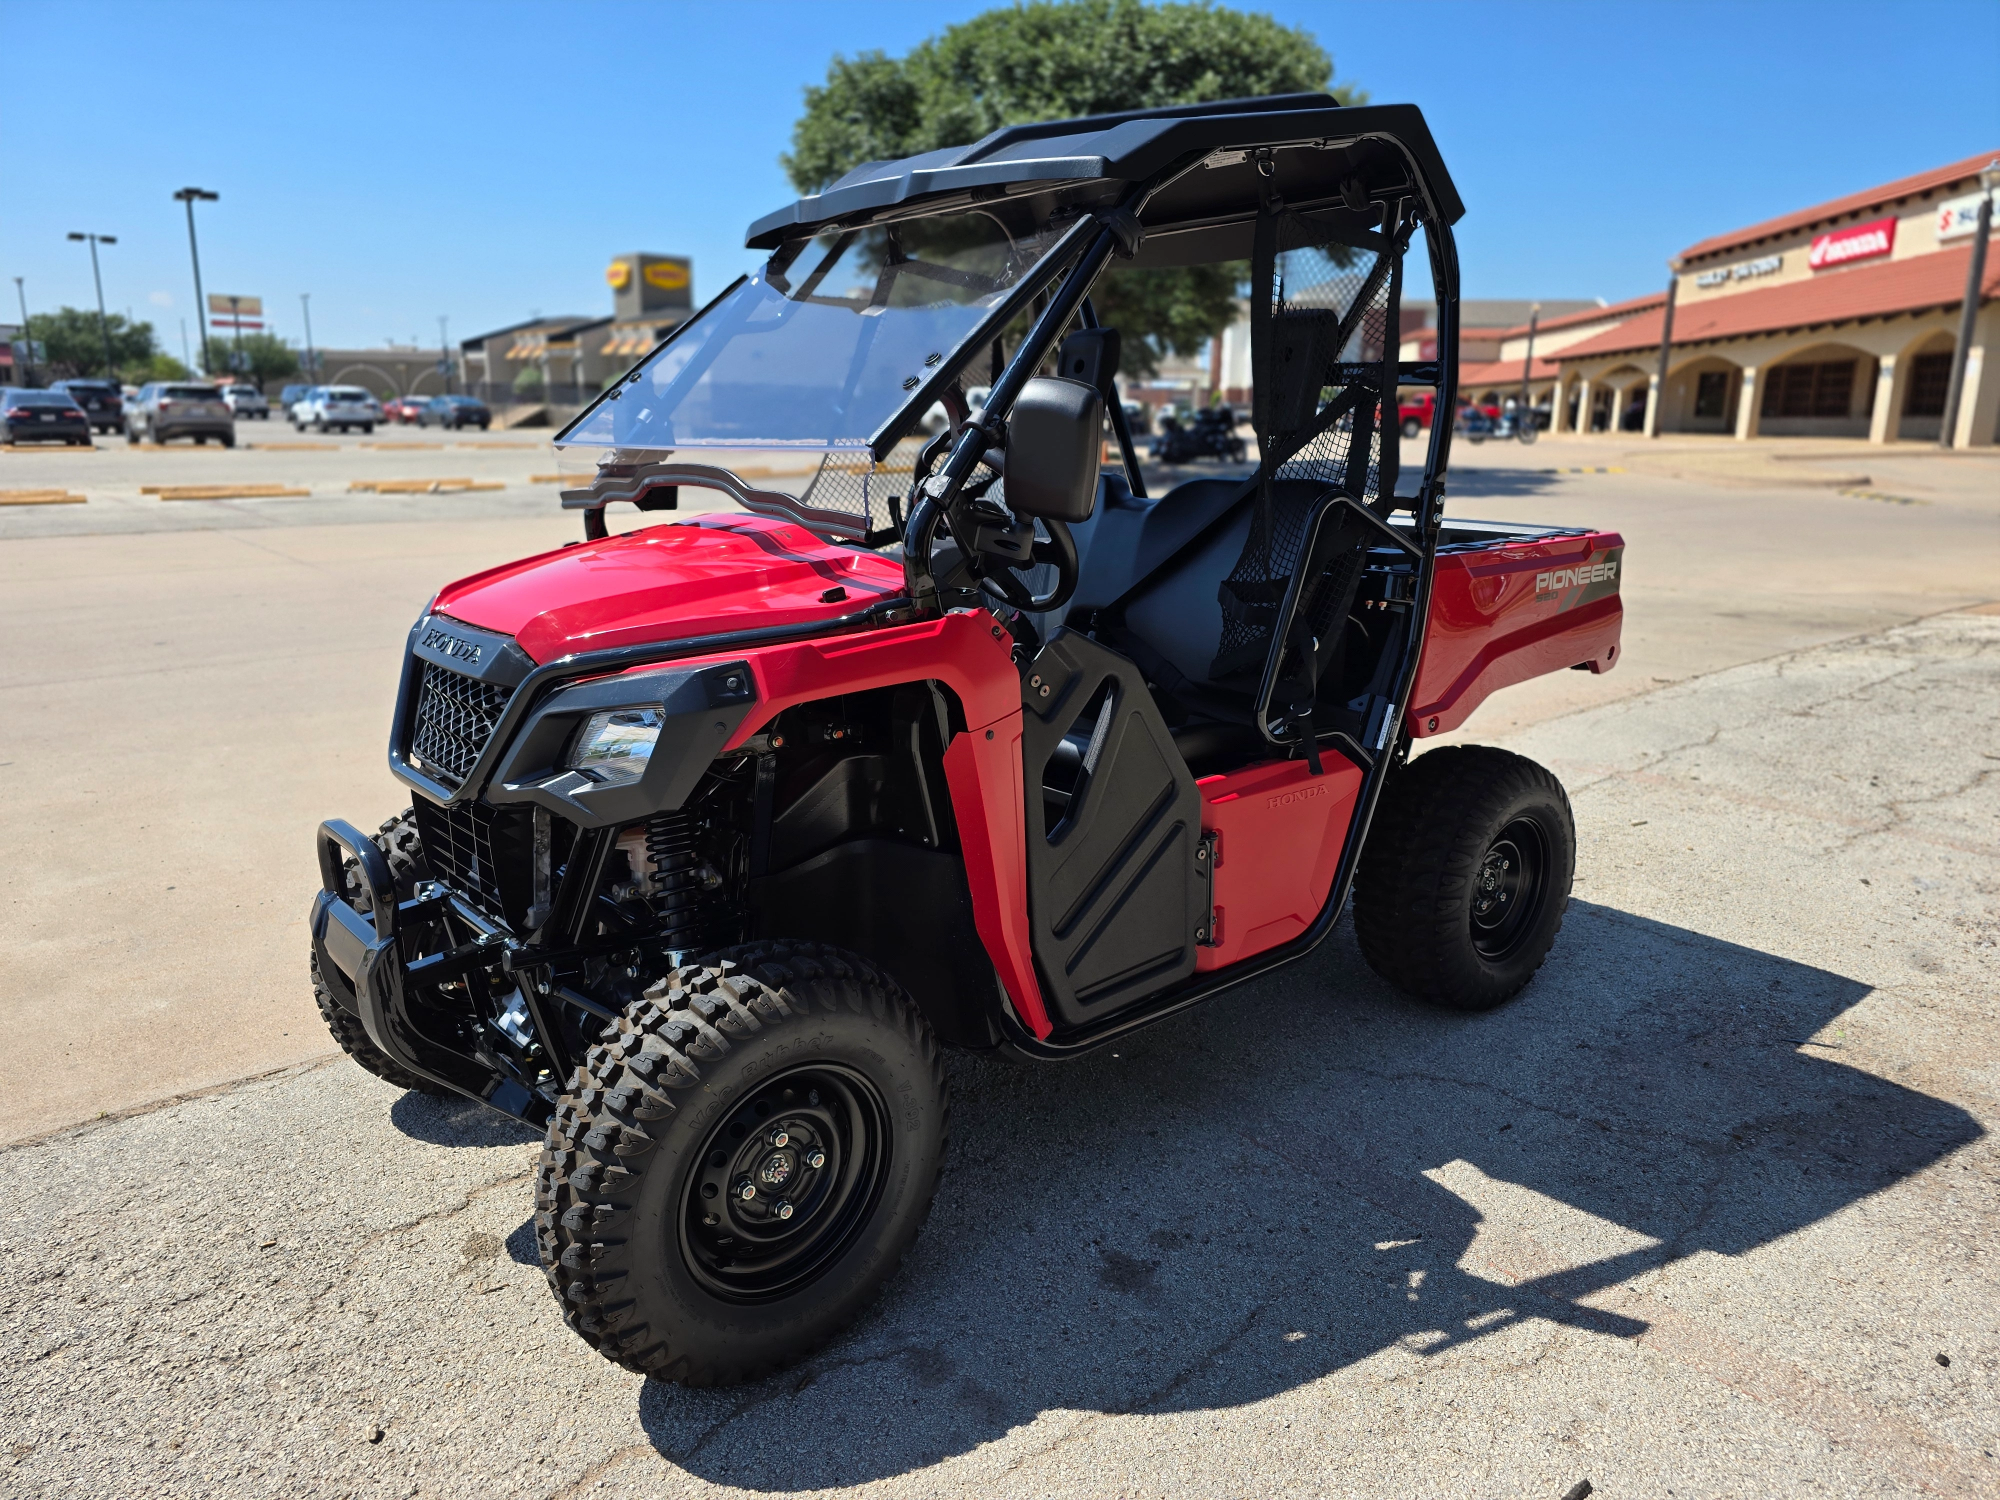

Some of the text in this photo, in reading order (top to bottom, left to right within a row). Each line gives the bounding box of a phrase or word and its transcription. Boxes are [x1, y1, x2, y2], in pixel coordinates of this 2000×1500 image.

[1536, 562, 1617, 592] PIONEER
[1536, 591, 1558, 603] 520
[422, 629, 482, 665] HONDA
[1267, 784, 1329, 809] HONDA
[688, 1086, 733, 1130] Vee
[741, 1035, 834, 1082] Rubber
